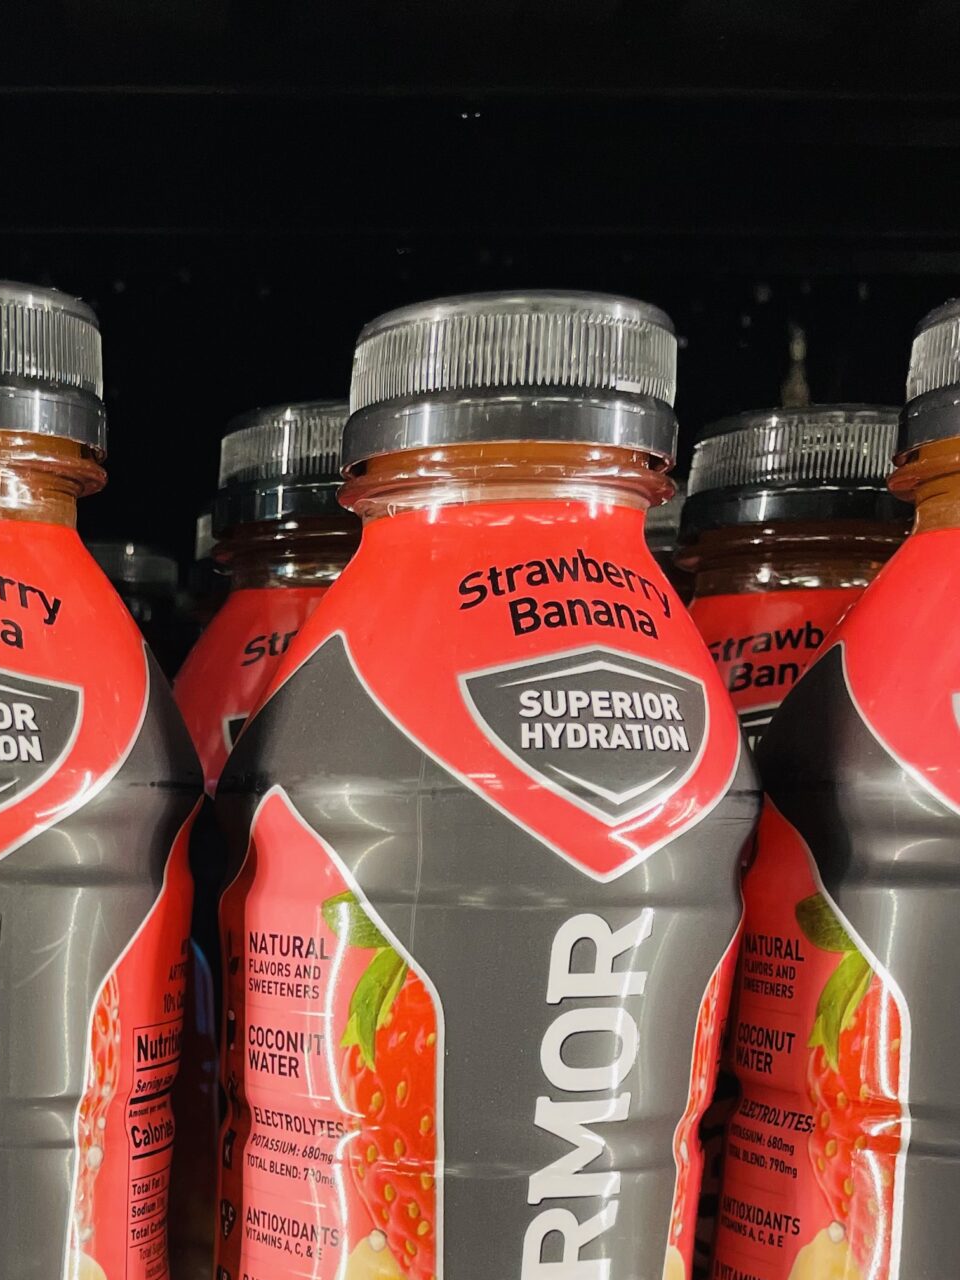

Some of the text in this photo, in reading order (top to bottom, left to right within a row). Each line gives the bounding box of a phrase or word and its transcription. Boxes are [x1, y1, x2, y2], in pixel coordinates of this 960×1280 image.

[458, 549, 671, 618] Strawberry
[508, 596, 659, 639] Banana
[708, 621, 825, 664] Strawb
[729, 662, 802, 693] Ban
[518, 690, 684, 722] SUPERIOR
[520, 722, 691, 752] HYDRATION
[249, 931, 331, 961] NATURAL
[744, 932, 804, 962] NATURAL
[249, 958, 321, 980] FLAVORS AND
[775, 965, 796, 981] AND
[249, 977, 320, 1000] SWEETENERS
[136, 1027, 181, 1063] Nutriti
[248, 1024, 325, 1056] COCONUT
[737, 1021, 796, 1054] COCONUT
[248, 1048, 300, 1079] WATER
[130, 1117, 174, 1149] Calories
[251, 1133, 300, 1157] POTASSIUM:
[767, 1134, 795, 1156] 680mg
[247, 1152, 301, 1180] TOTAL BLEND:
[768, 1156, 798, 1179] 790mg
[132, 1182, 150, 1196] Total
[246, 1206, 340, 1247] ANTIOXIDANTS
[246, 1227, 282, 1249] VITAMINS
